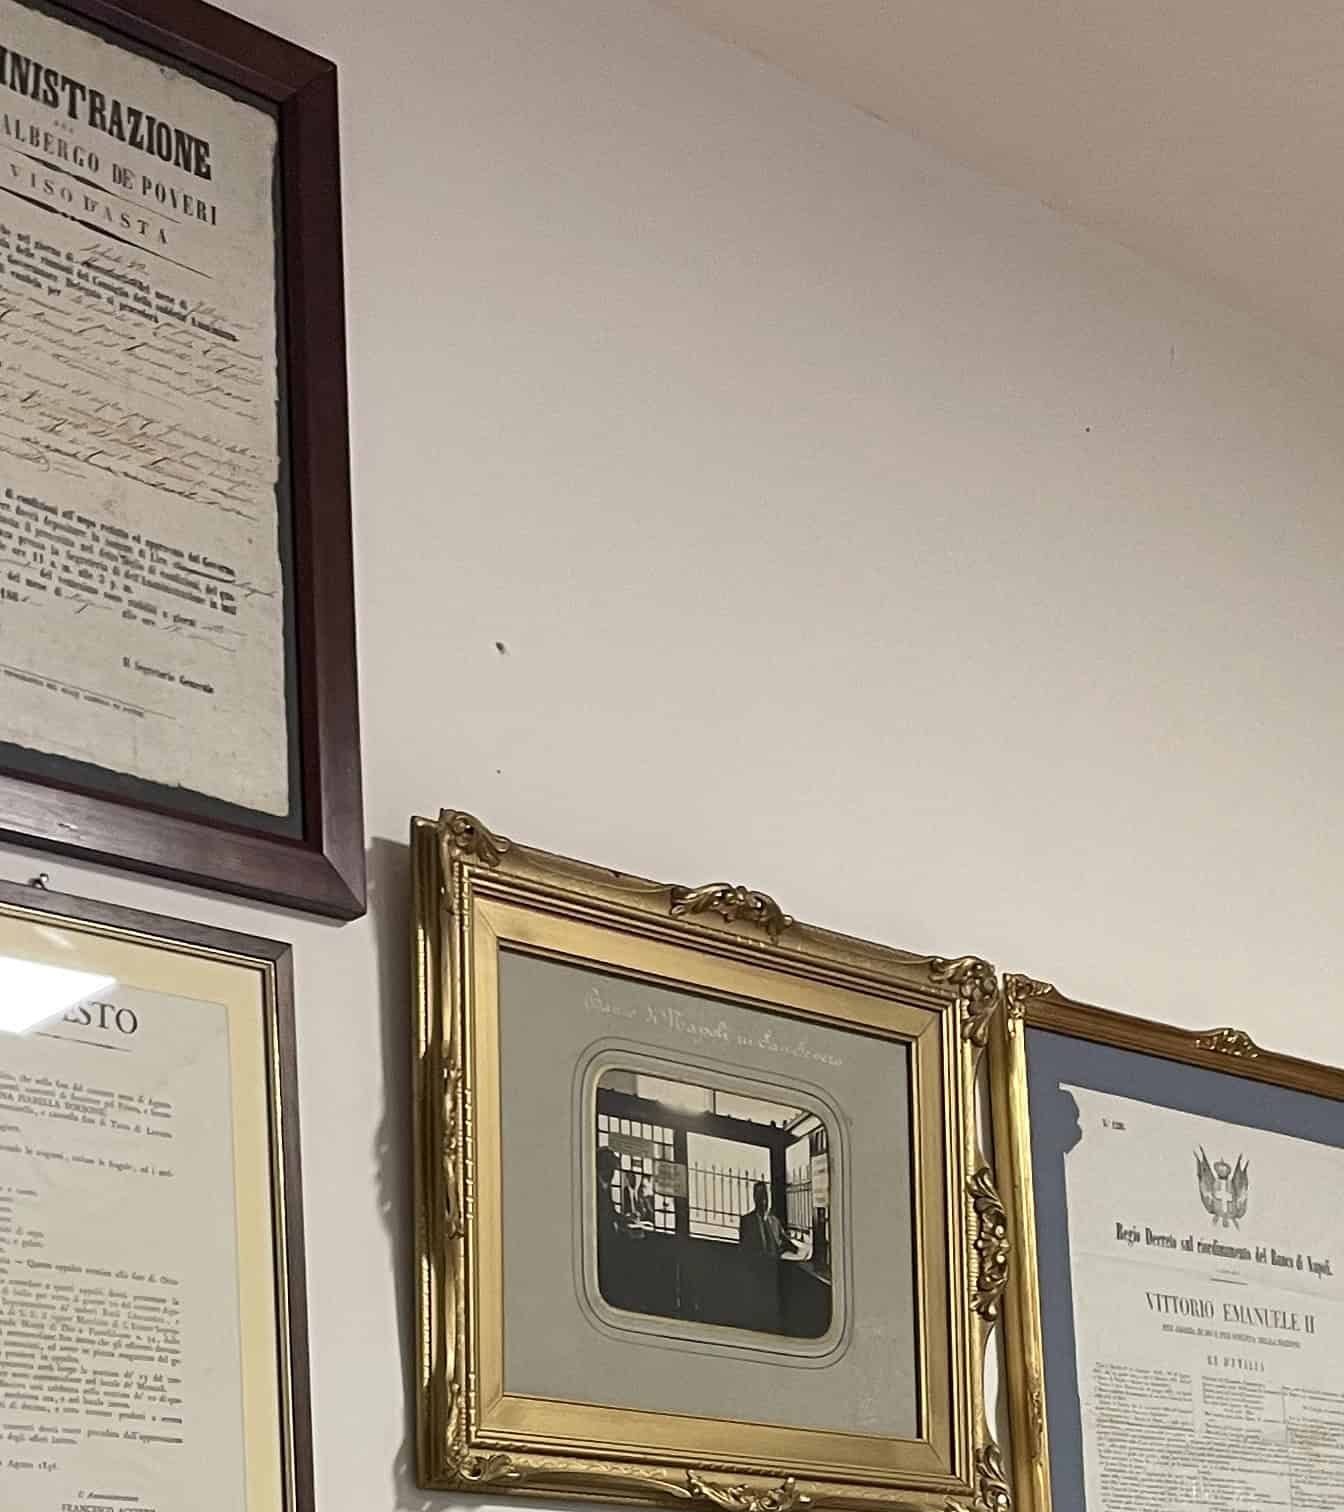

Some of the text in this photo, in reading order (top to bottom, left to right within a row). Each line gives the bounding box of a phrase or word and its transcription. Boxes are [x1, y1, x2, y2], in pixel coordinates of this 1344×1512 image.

[3, 112, 99, 173] ALBERGO
[142, 173, 217, 226] POVERI
[1116, 1222, 1140, 1248] Regio
[1145, 1292, 1315, 1334] VITTORIO EMANUELE II
